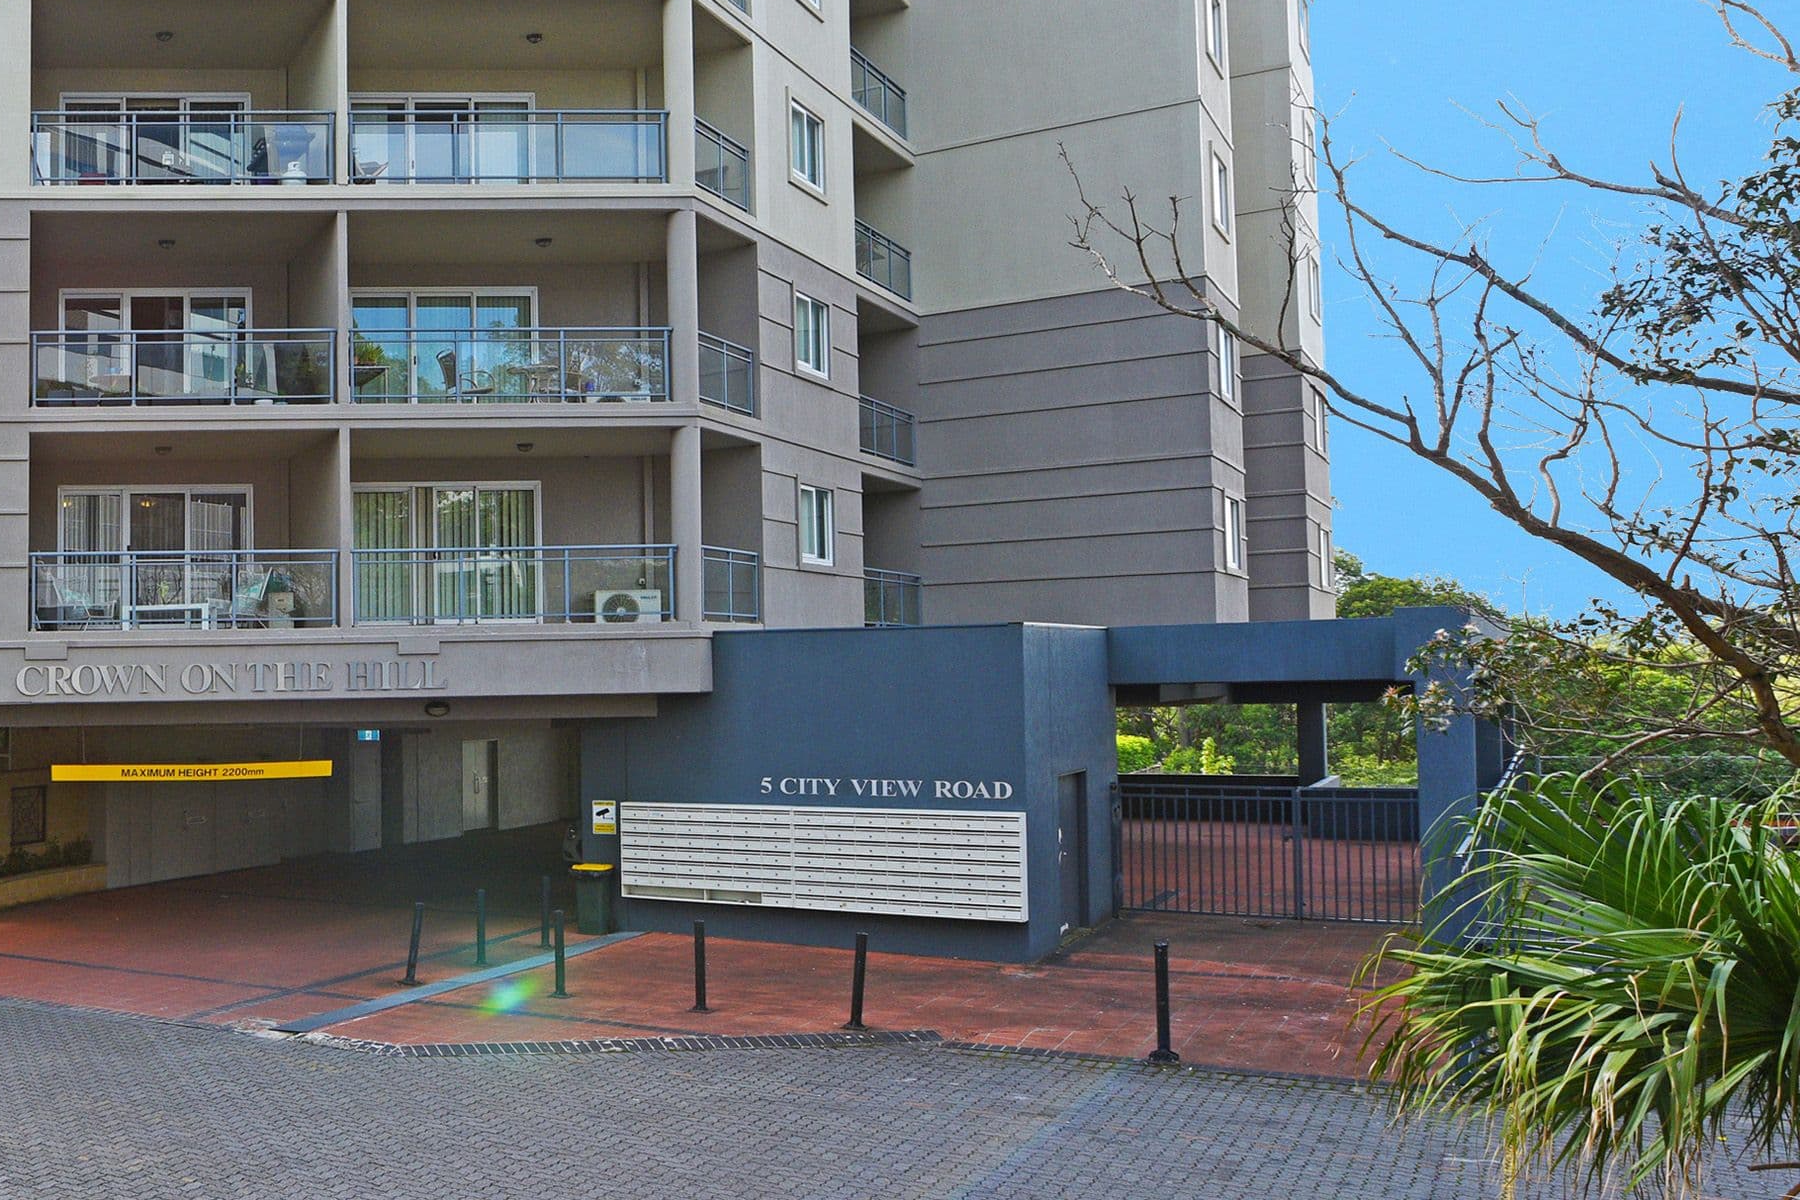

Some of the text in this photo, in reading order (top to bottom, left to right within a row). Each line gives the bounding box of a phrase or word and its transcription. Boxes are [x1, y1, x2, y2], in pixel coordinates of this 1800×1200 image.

[16, 660, 448, 696] CROWN ON THE HILL
[120, 767, 265, 777] MAXIMUM HEIGHT 2200mm
[760, 777, 1013, 800] 5 CITY VIEW ROAD
